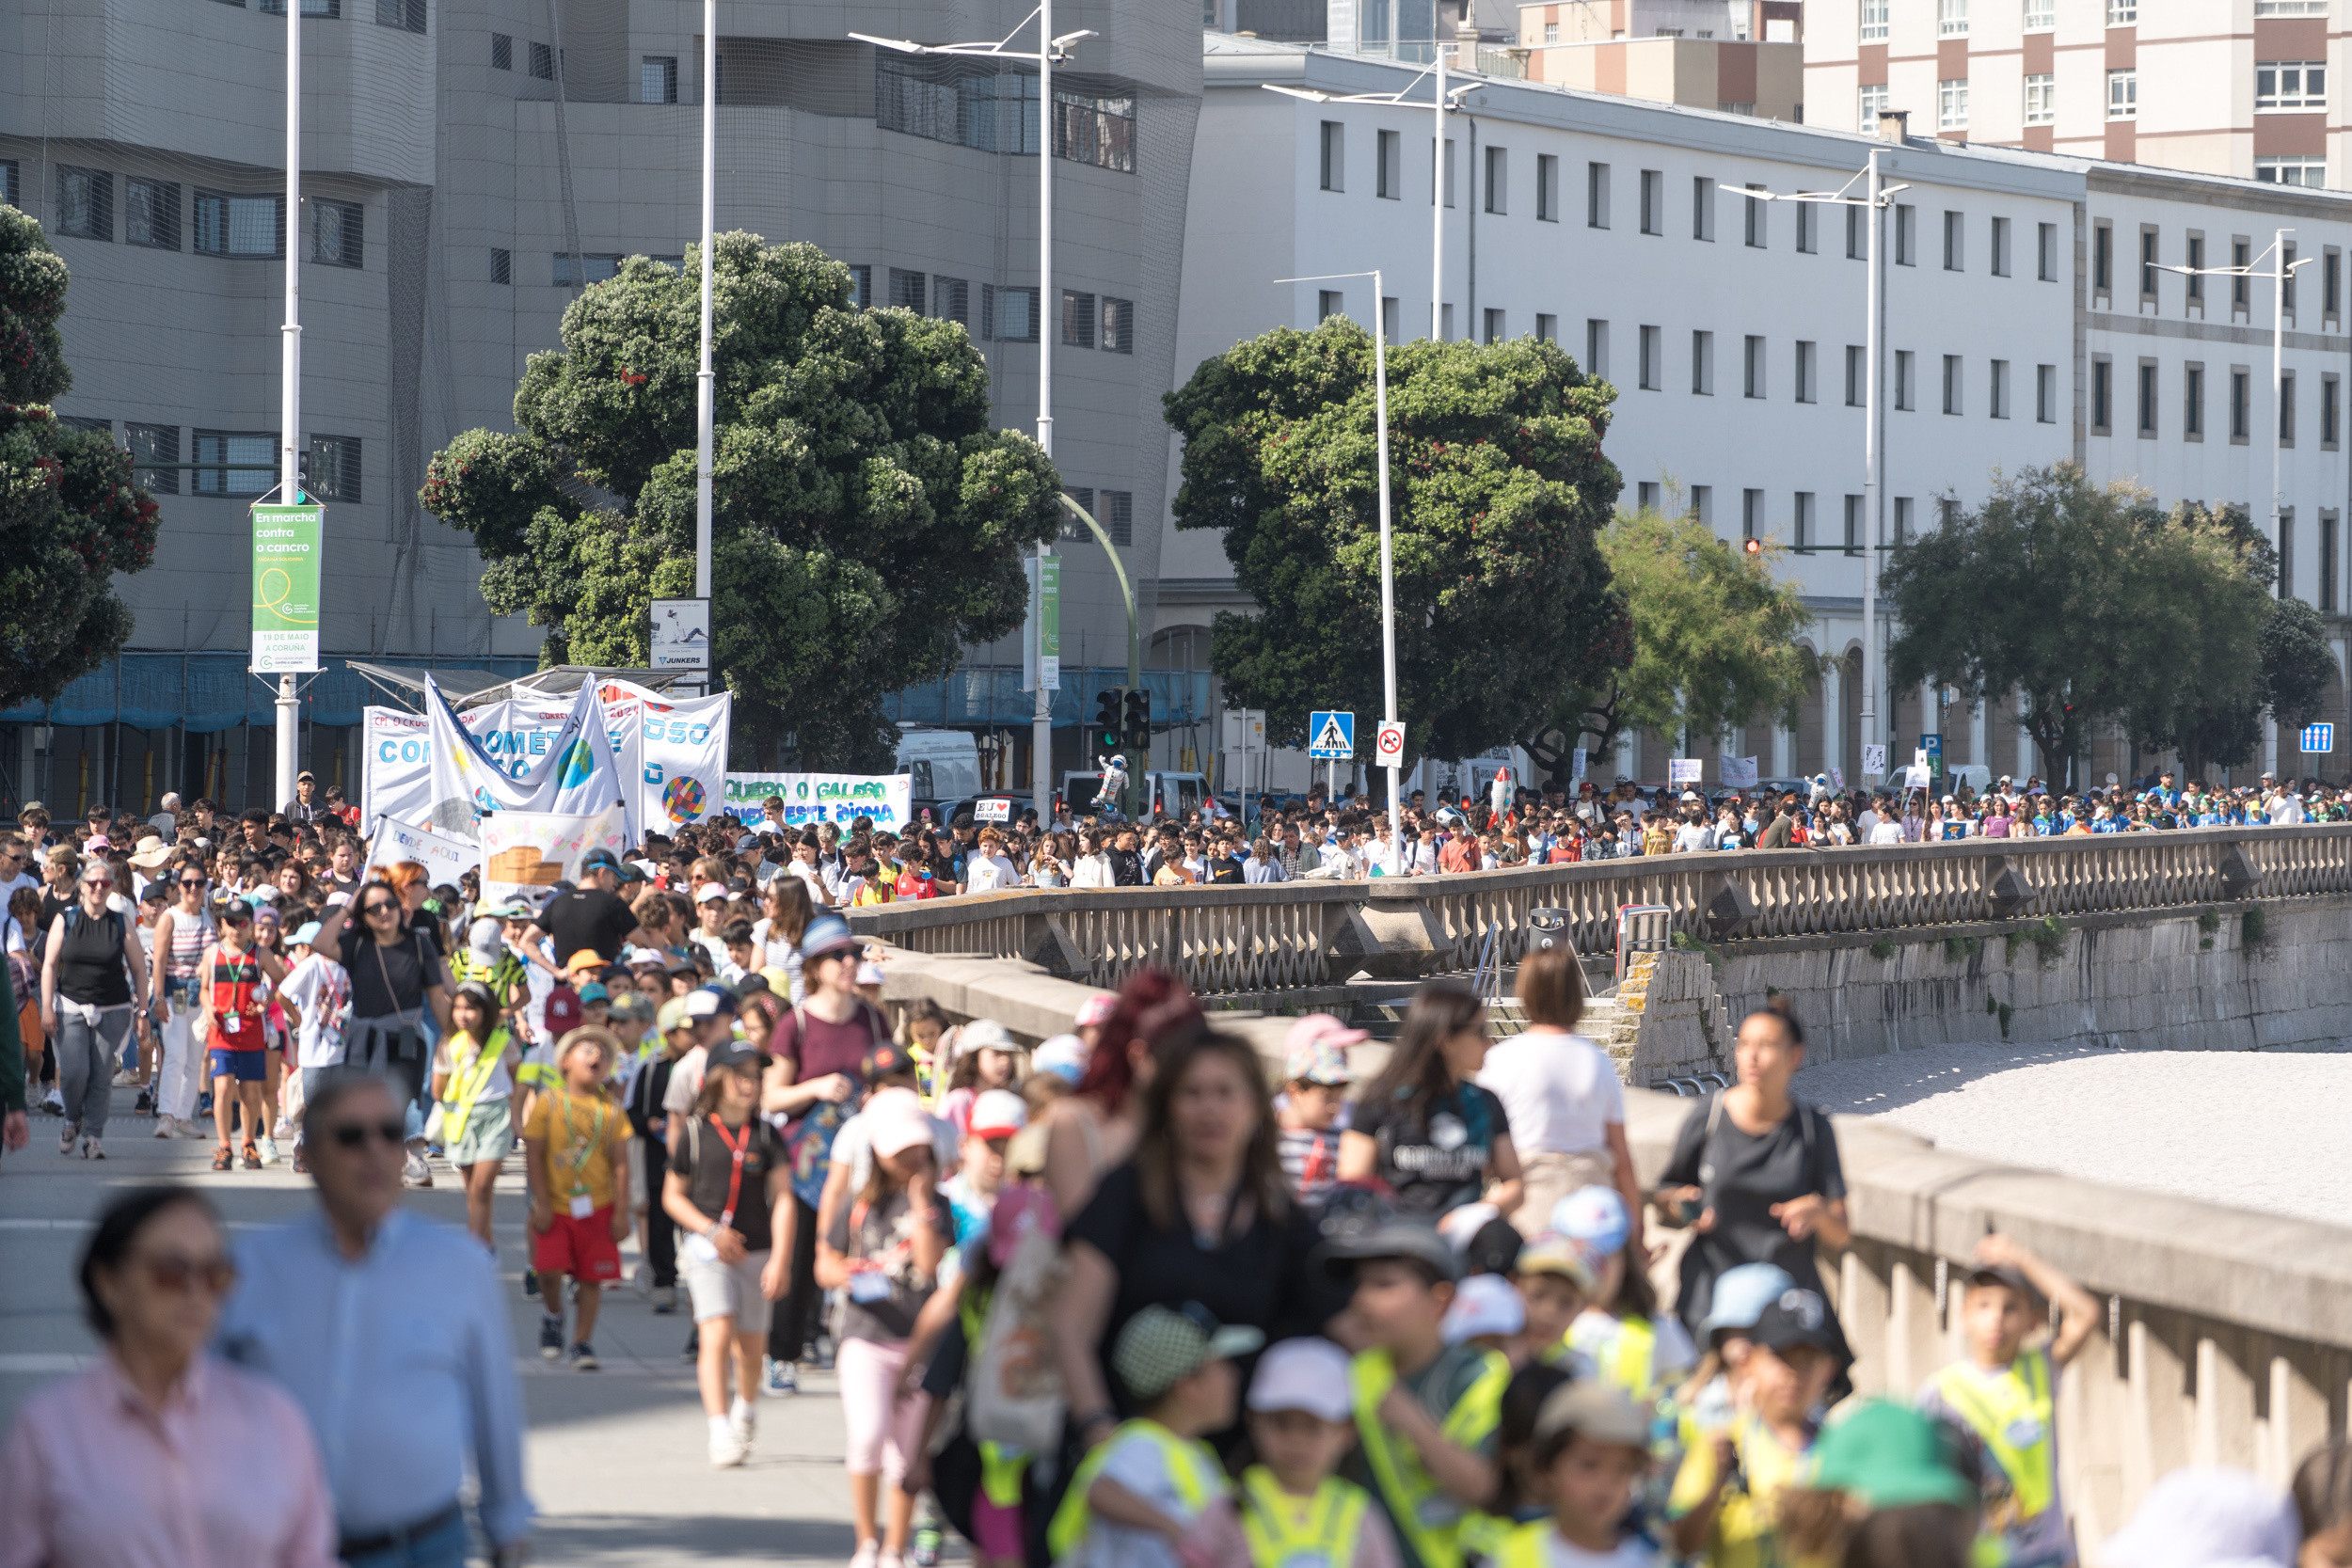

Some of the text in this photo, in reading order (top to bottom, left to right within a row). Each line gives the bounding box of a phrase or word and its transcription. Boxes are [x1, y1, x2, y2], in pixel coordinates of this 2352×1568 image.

[256, 512, 316, 523] En marcha
[256, 528, 294, 538] contra
[266, 544, 310, 552] cancro
[374, 717, 388, 726] CPI
[1925, 736, 1938, 753] P
[723, 779, 887, 803] QUERO O GALEGO
[977, 802, 995, 812] EU
[785, 805, 827, 825] ESTE
[2037, 825, 2050, 835] 21
[2103, 823, 2116, 833] 21
